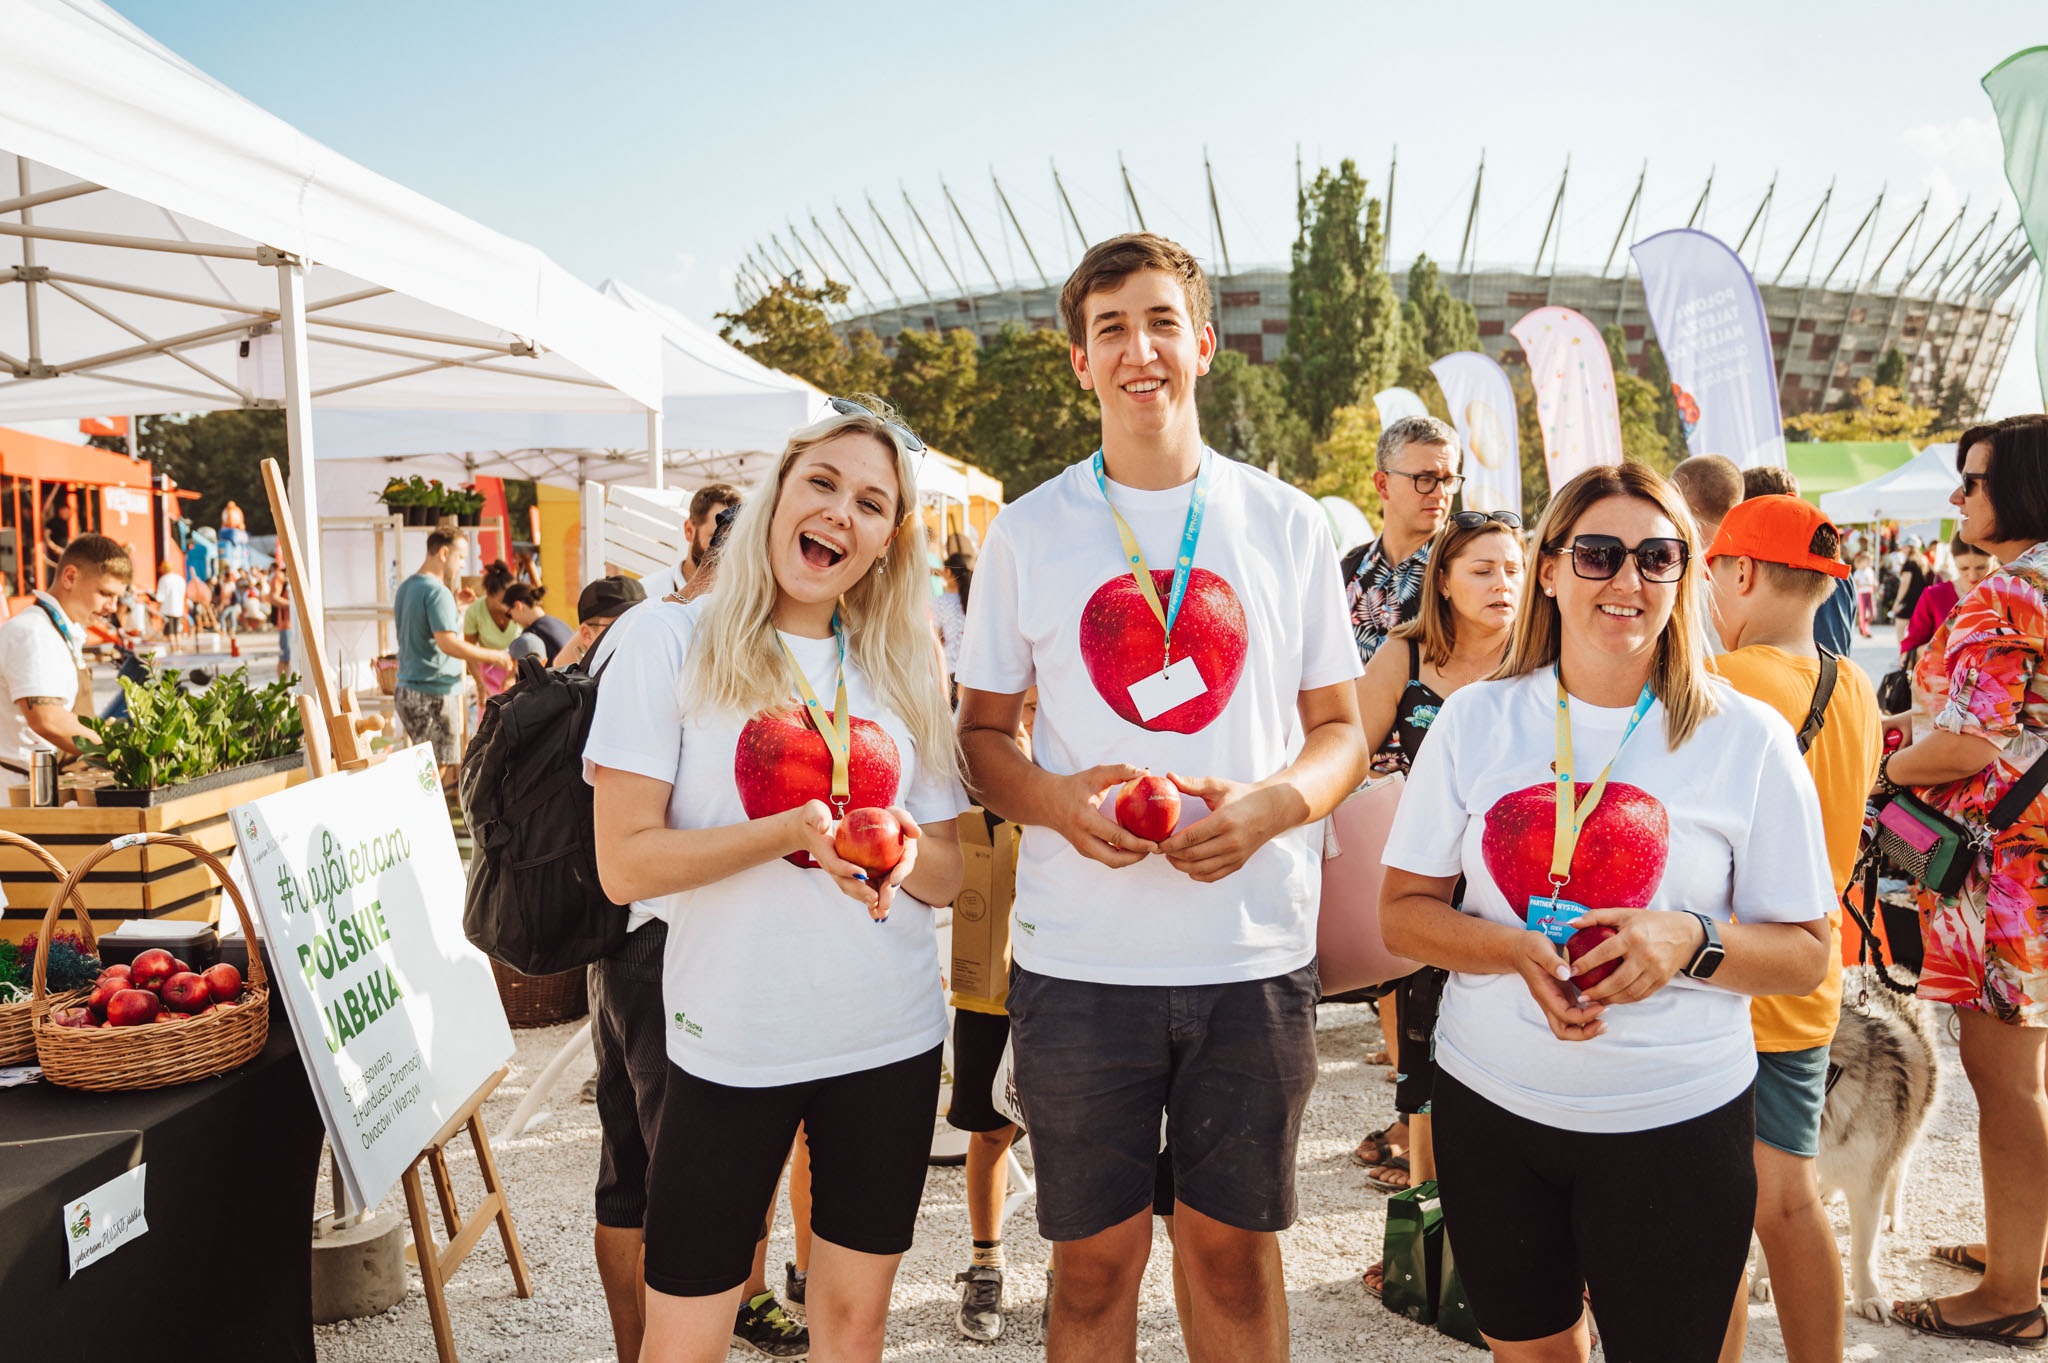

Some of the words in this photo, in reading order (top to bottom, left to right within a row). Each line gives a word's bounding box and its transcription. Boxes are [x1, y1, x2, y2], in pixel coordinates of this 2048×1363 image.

[277, 827, 411, 925] #wybieram
[296, 899, 391, 993] POLSKIE
[323, 962, 405, 1055] JABŁKA
[352, 1113, 361, 1128] z
[357, 1083, 393, 1122] Funduszu
[389, 1049, 422, 1089] Promocji
[389, 1103, 396, 1120] i
[392, 1082, 422, 1116] Warzyw
[361, 1112, 393, 1150] Owoców
